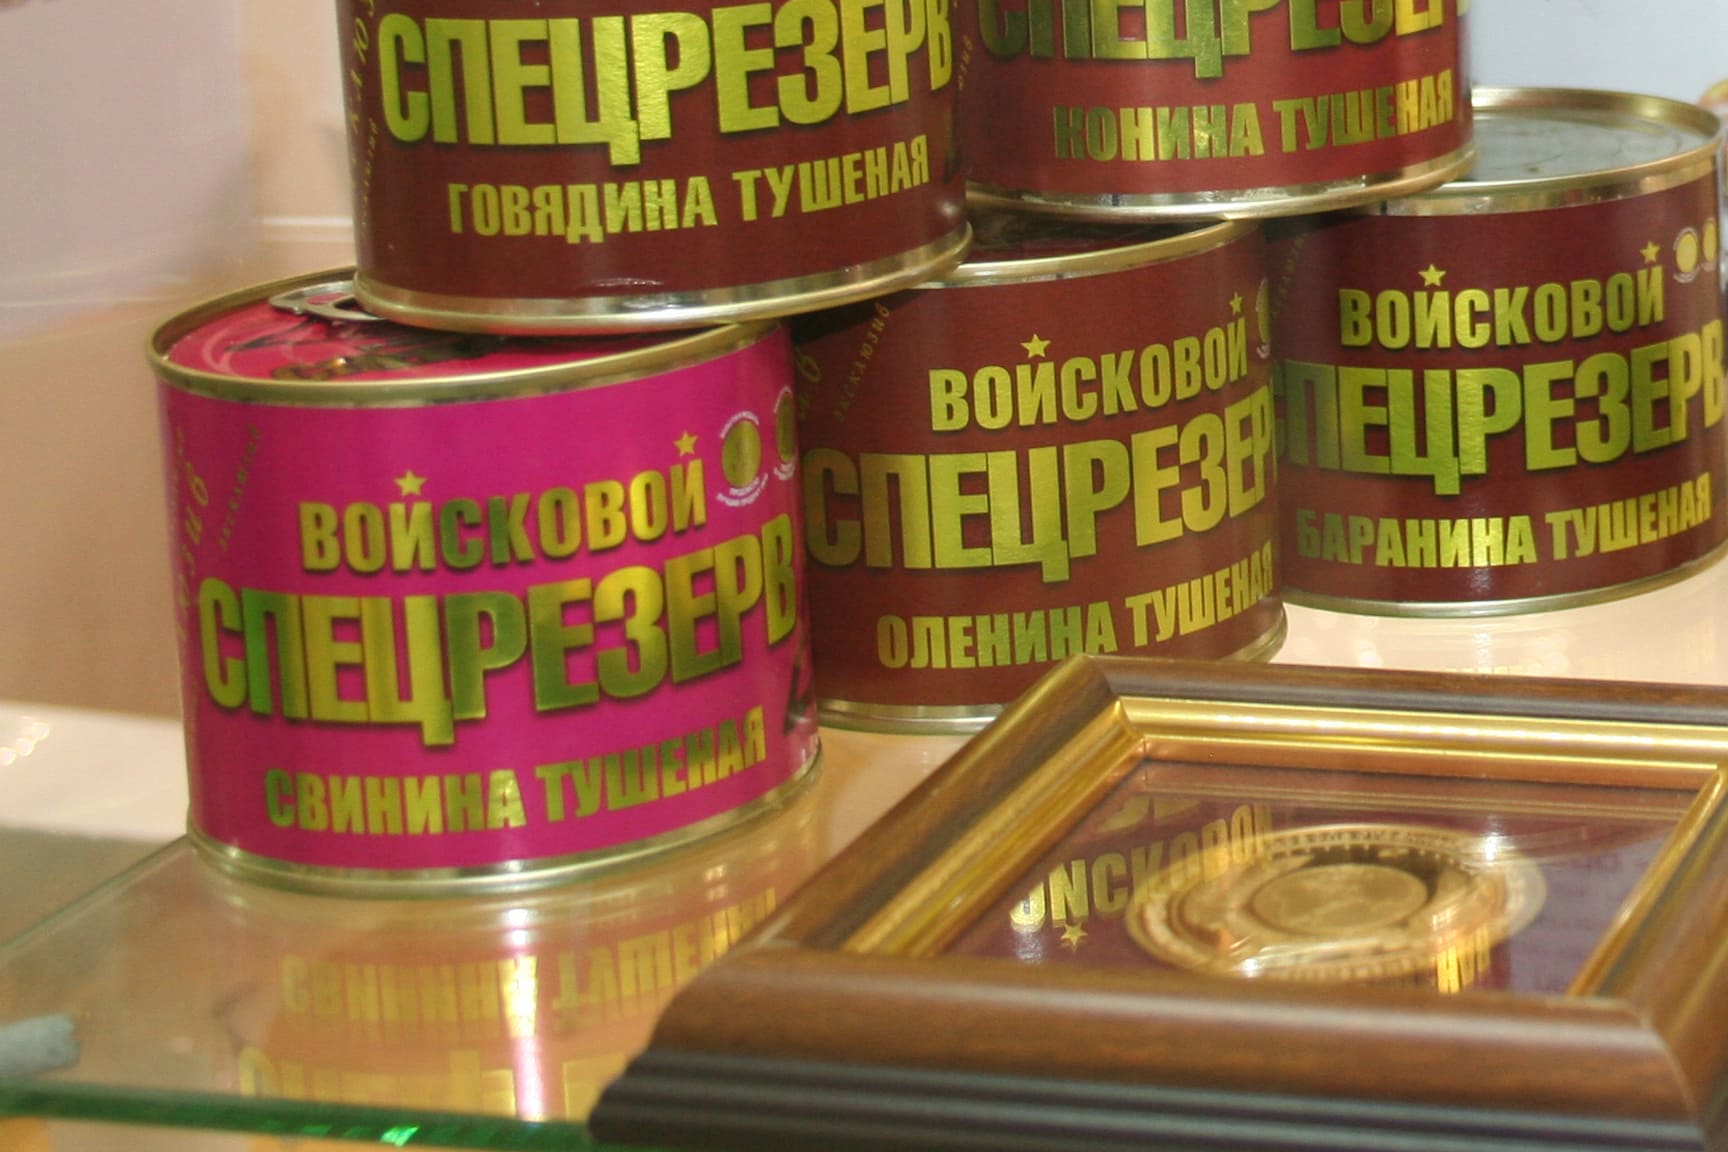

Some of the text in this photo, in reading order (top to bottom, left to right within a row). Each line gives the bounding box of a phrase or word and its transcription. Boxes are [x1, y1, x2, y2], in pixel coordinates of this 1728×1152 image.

[1053, 68, 1454, 162] КОНИНА ТУШЕНАЯ
[448, 134, 930, 244] ГОВЯДИНА ТУШЕНАЯ
[1339, 265, 1665, 349] ВОЙСКОВОЙ
[928, 317, 1248, 432] ВОЙСКОВОЙ
[300, 458, 707, 574] ВОЙСКОВОЙ
[803, 383, 1276, 583] СПЕЦРЕЗЕР
[1297, 472, 1711, 568] БАРАНИНА ТУШЕНАЯ
[199, 513, 798, 746] СПЕЦРЕЗЕРВ
[876, 540, 1273, 670] ОЛЕНИНА ТУШЕНАЯ
[263, 705, 768, 835] СВИНИНА ТУШЕНАЯ
